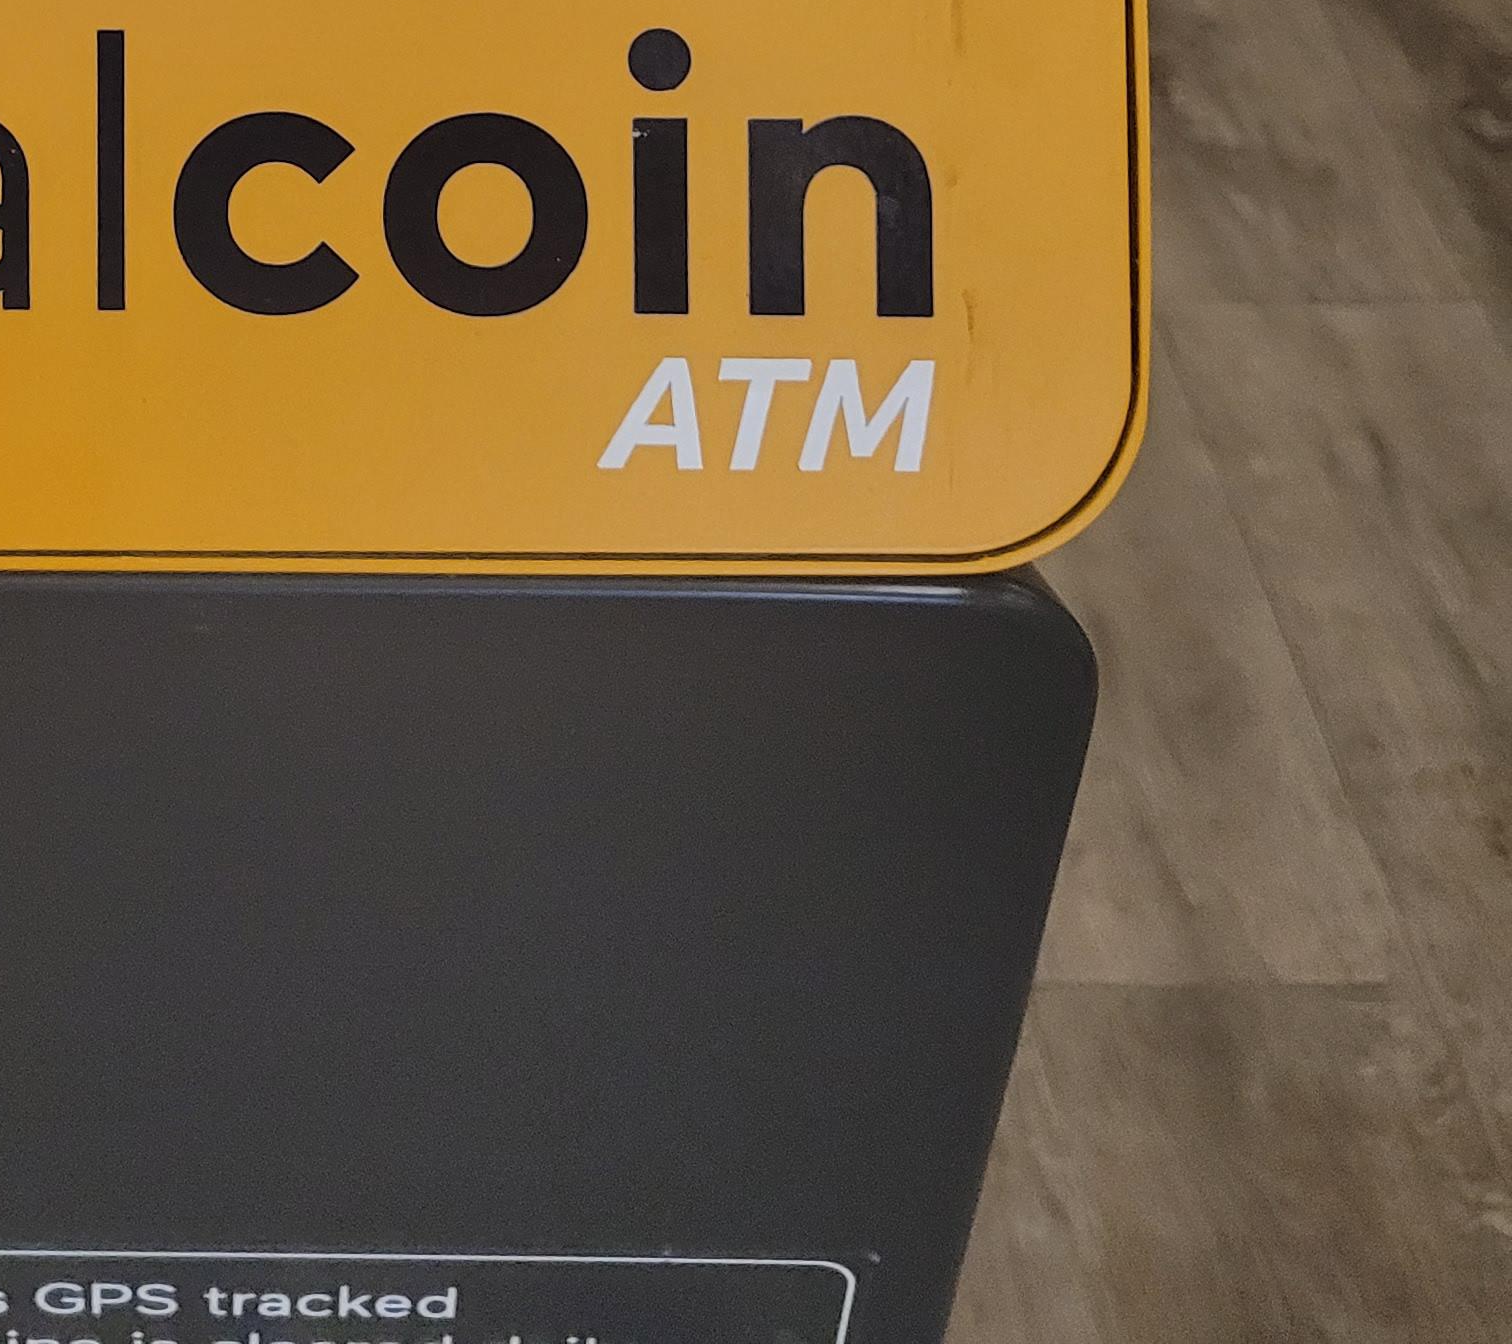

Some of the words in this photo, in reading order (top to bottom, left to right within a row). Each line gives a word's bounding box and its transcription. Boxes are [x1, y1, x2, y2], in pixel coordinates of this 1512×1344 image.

[597, 358, 935, 472] ATM
[35, 1282, 178, 1315] GPS
[204, 1285, 457, 1318] tracked
